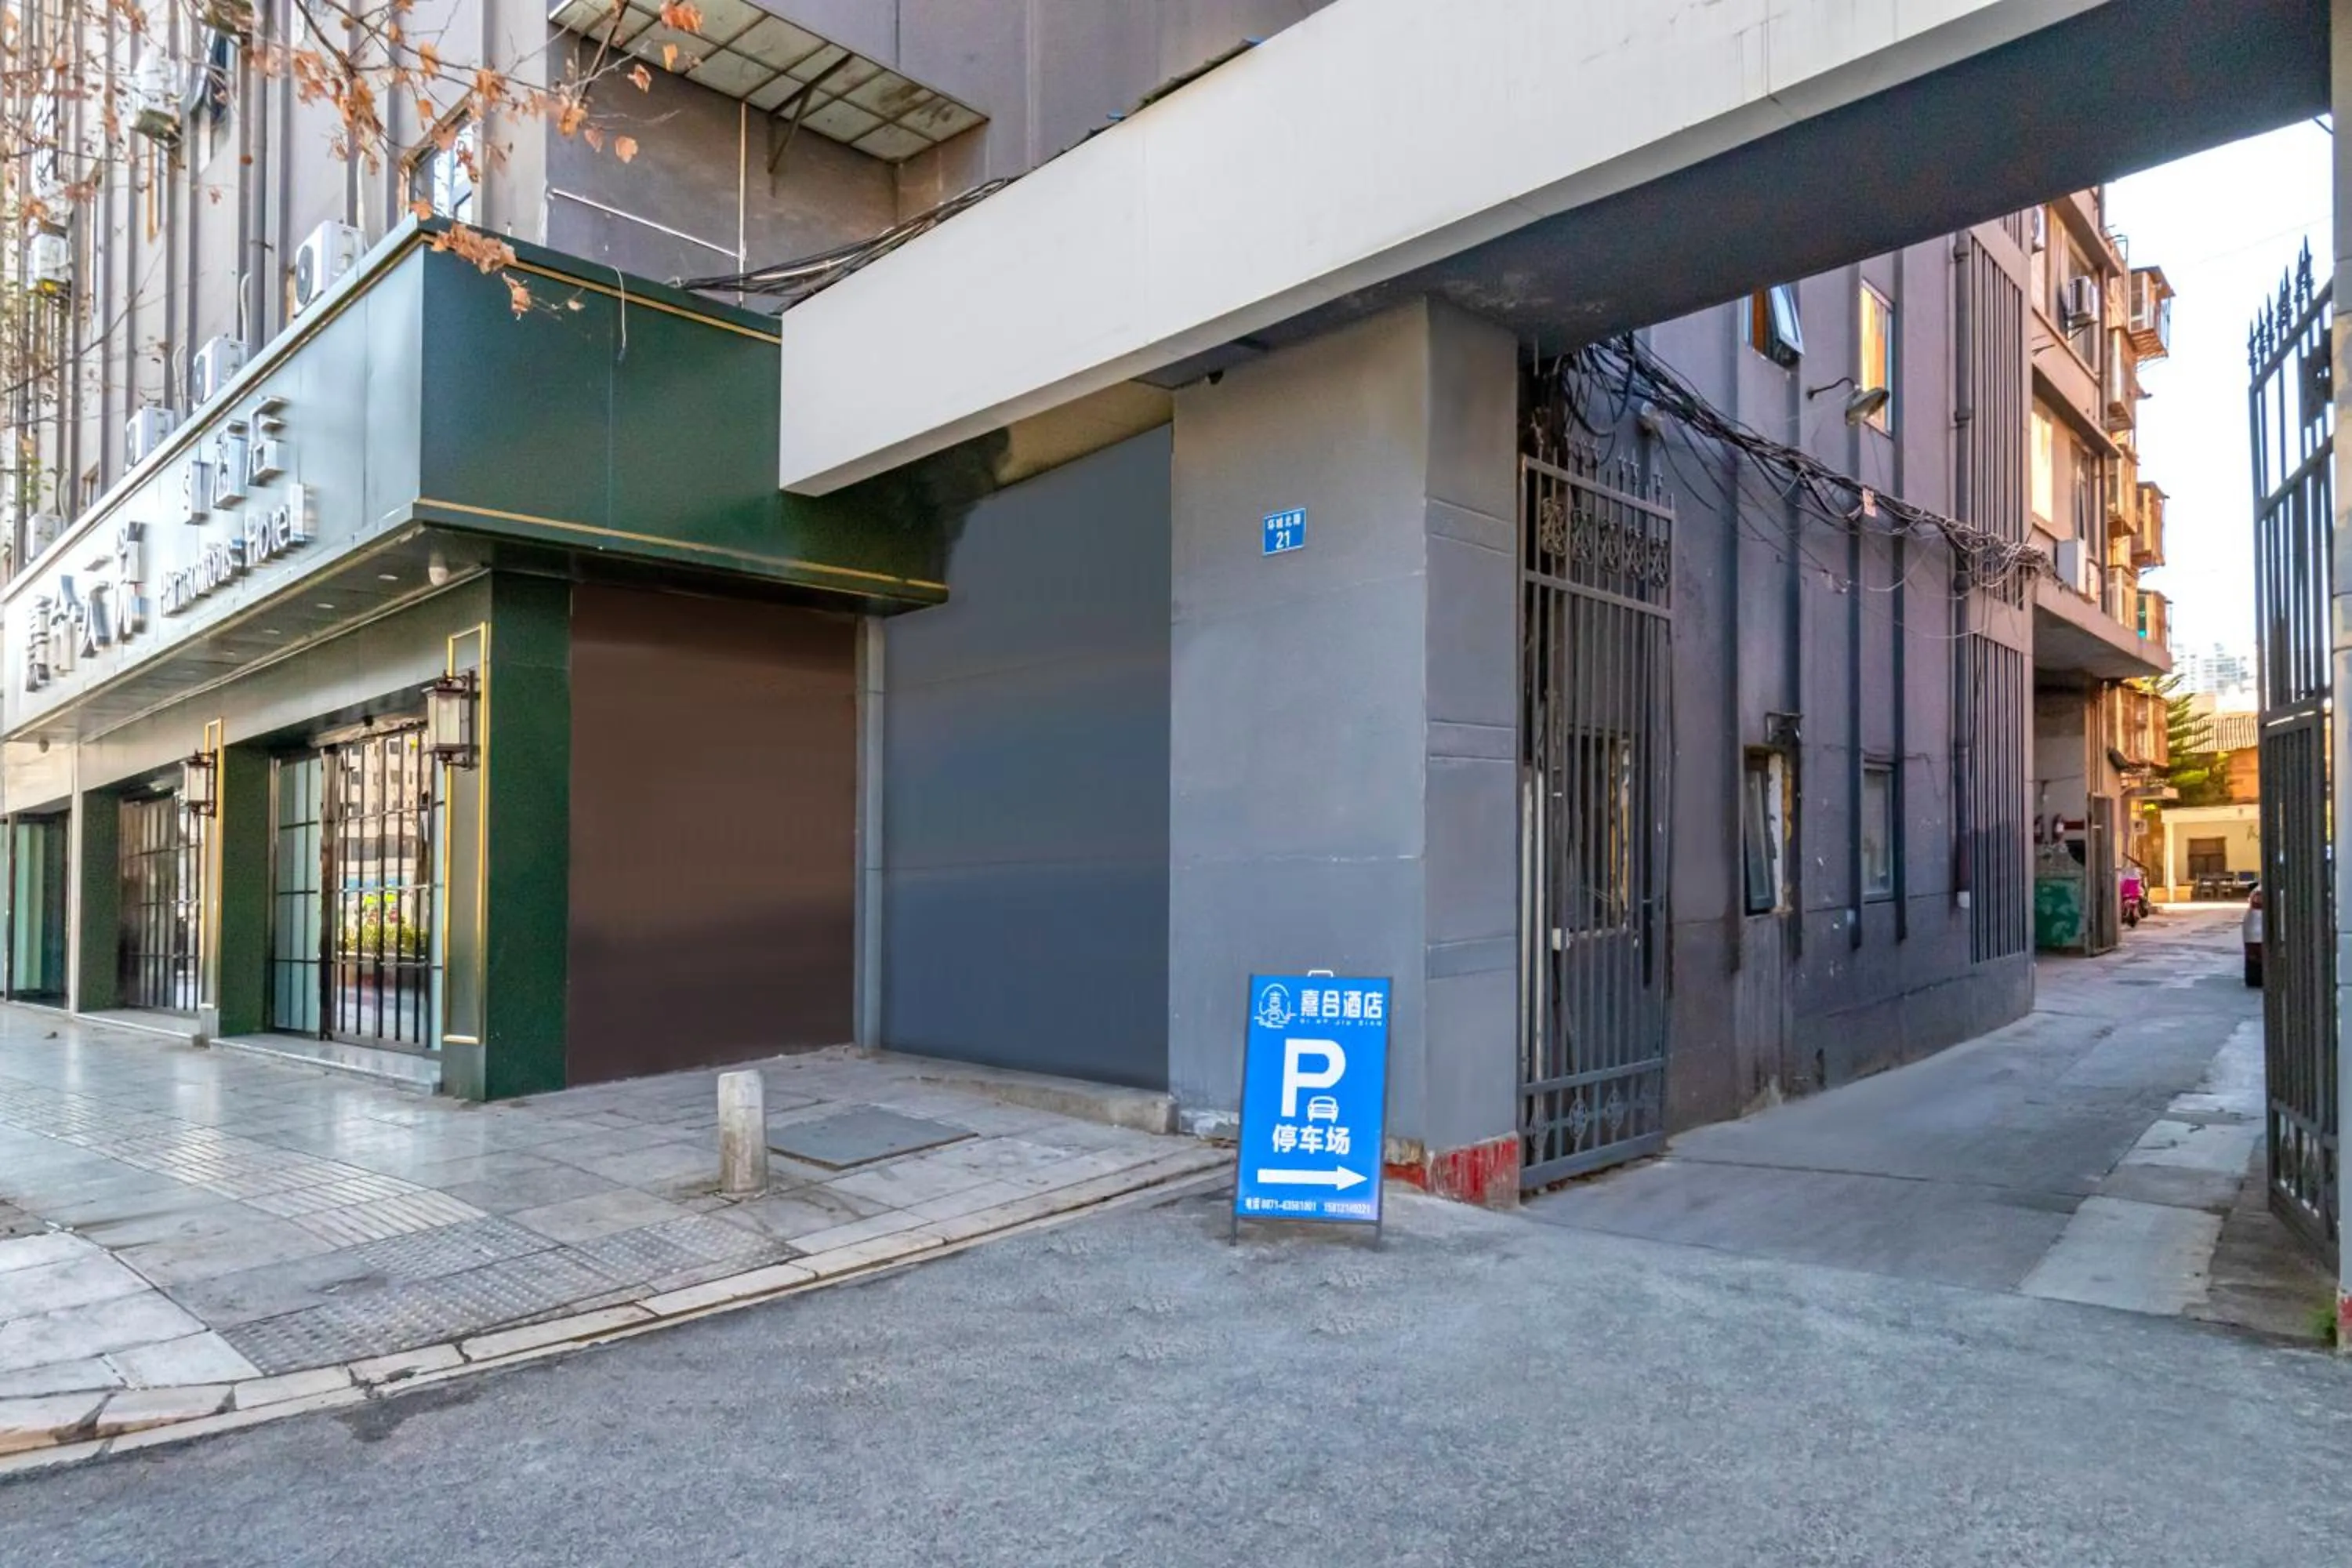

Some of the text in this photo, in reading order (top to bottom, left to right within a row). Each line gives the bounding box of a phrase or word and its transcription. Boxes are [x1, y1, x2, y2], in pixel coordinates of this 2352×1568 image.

[245, 483, 314, 568] Hotel
[1276, 530, 1290, 550] 21
[1280, 1038, 1346, 1117] P
[1272, 1124, 1351, 1156] 停车场
